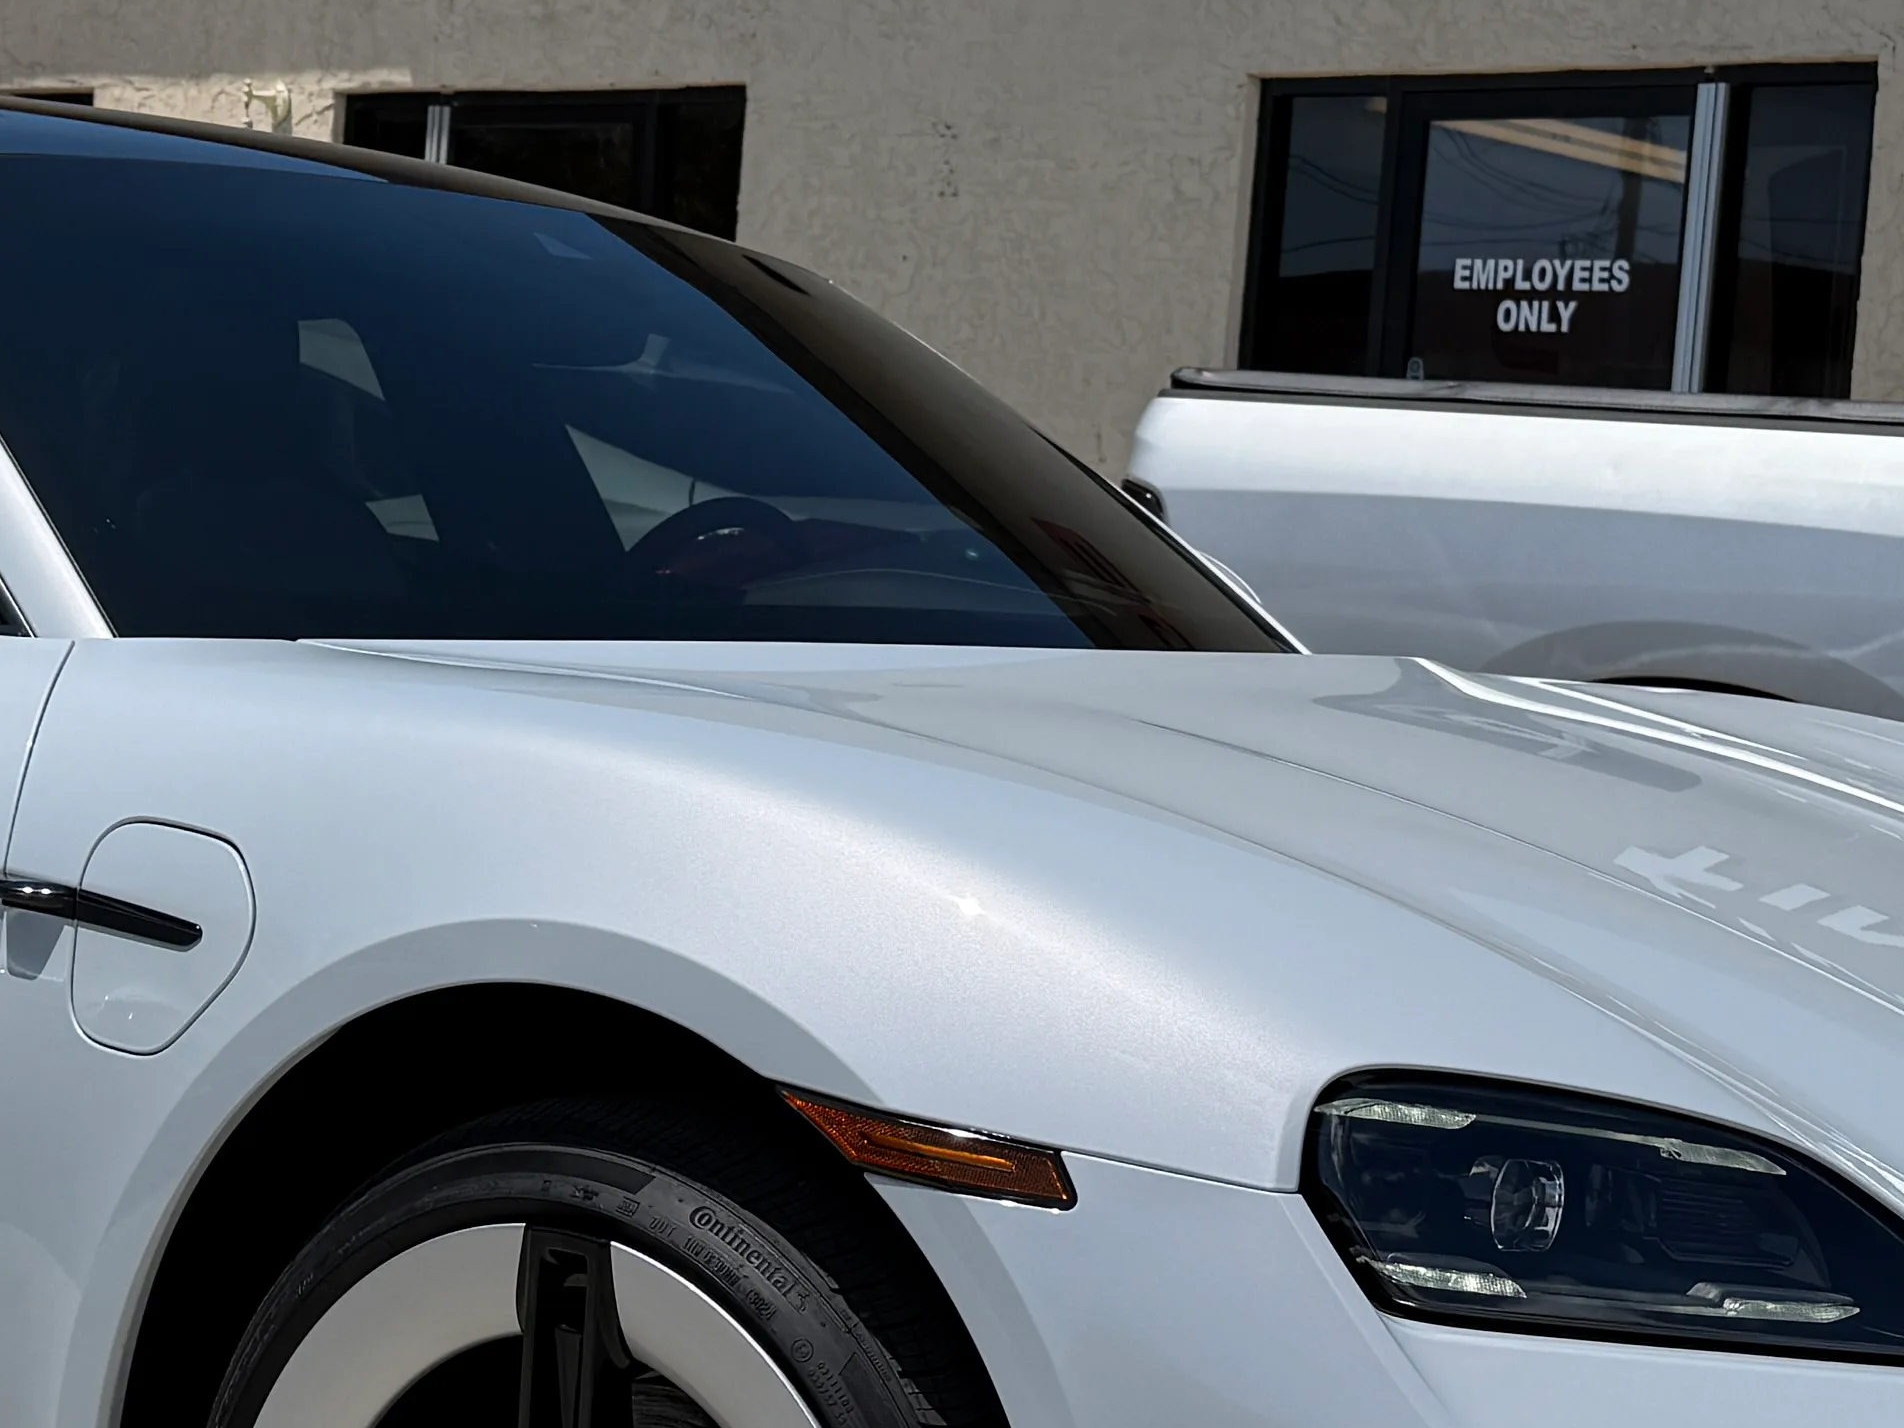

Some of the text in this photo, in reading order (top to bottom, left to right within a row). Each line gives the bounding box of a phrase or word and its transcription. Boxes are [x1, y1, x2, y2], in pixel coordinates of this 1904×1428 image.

[1452, 257, 1631, 292] EMPLOYEES
[1496, 299, 1578, 333] ONLY
[688, 1205, 796, 1298] Continental
